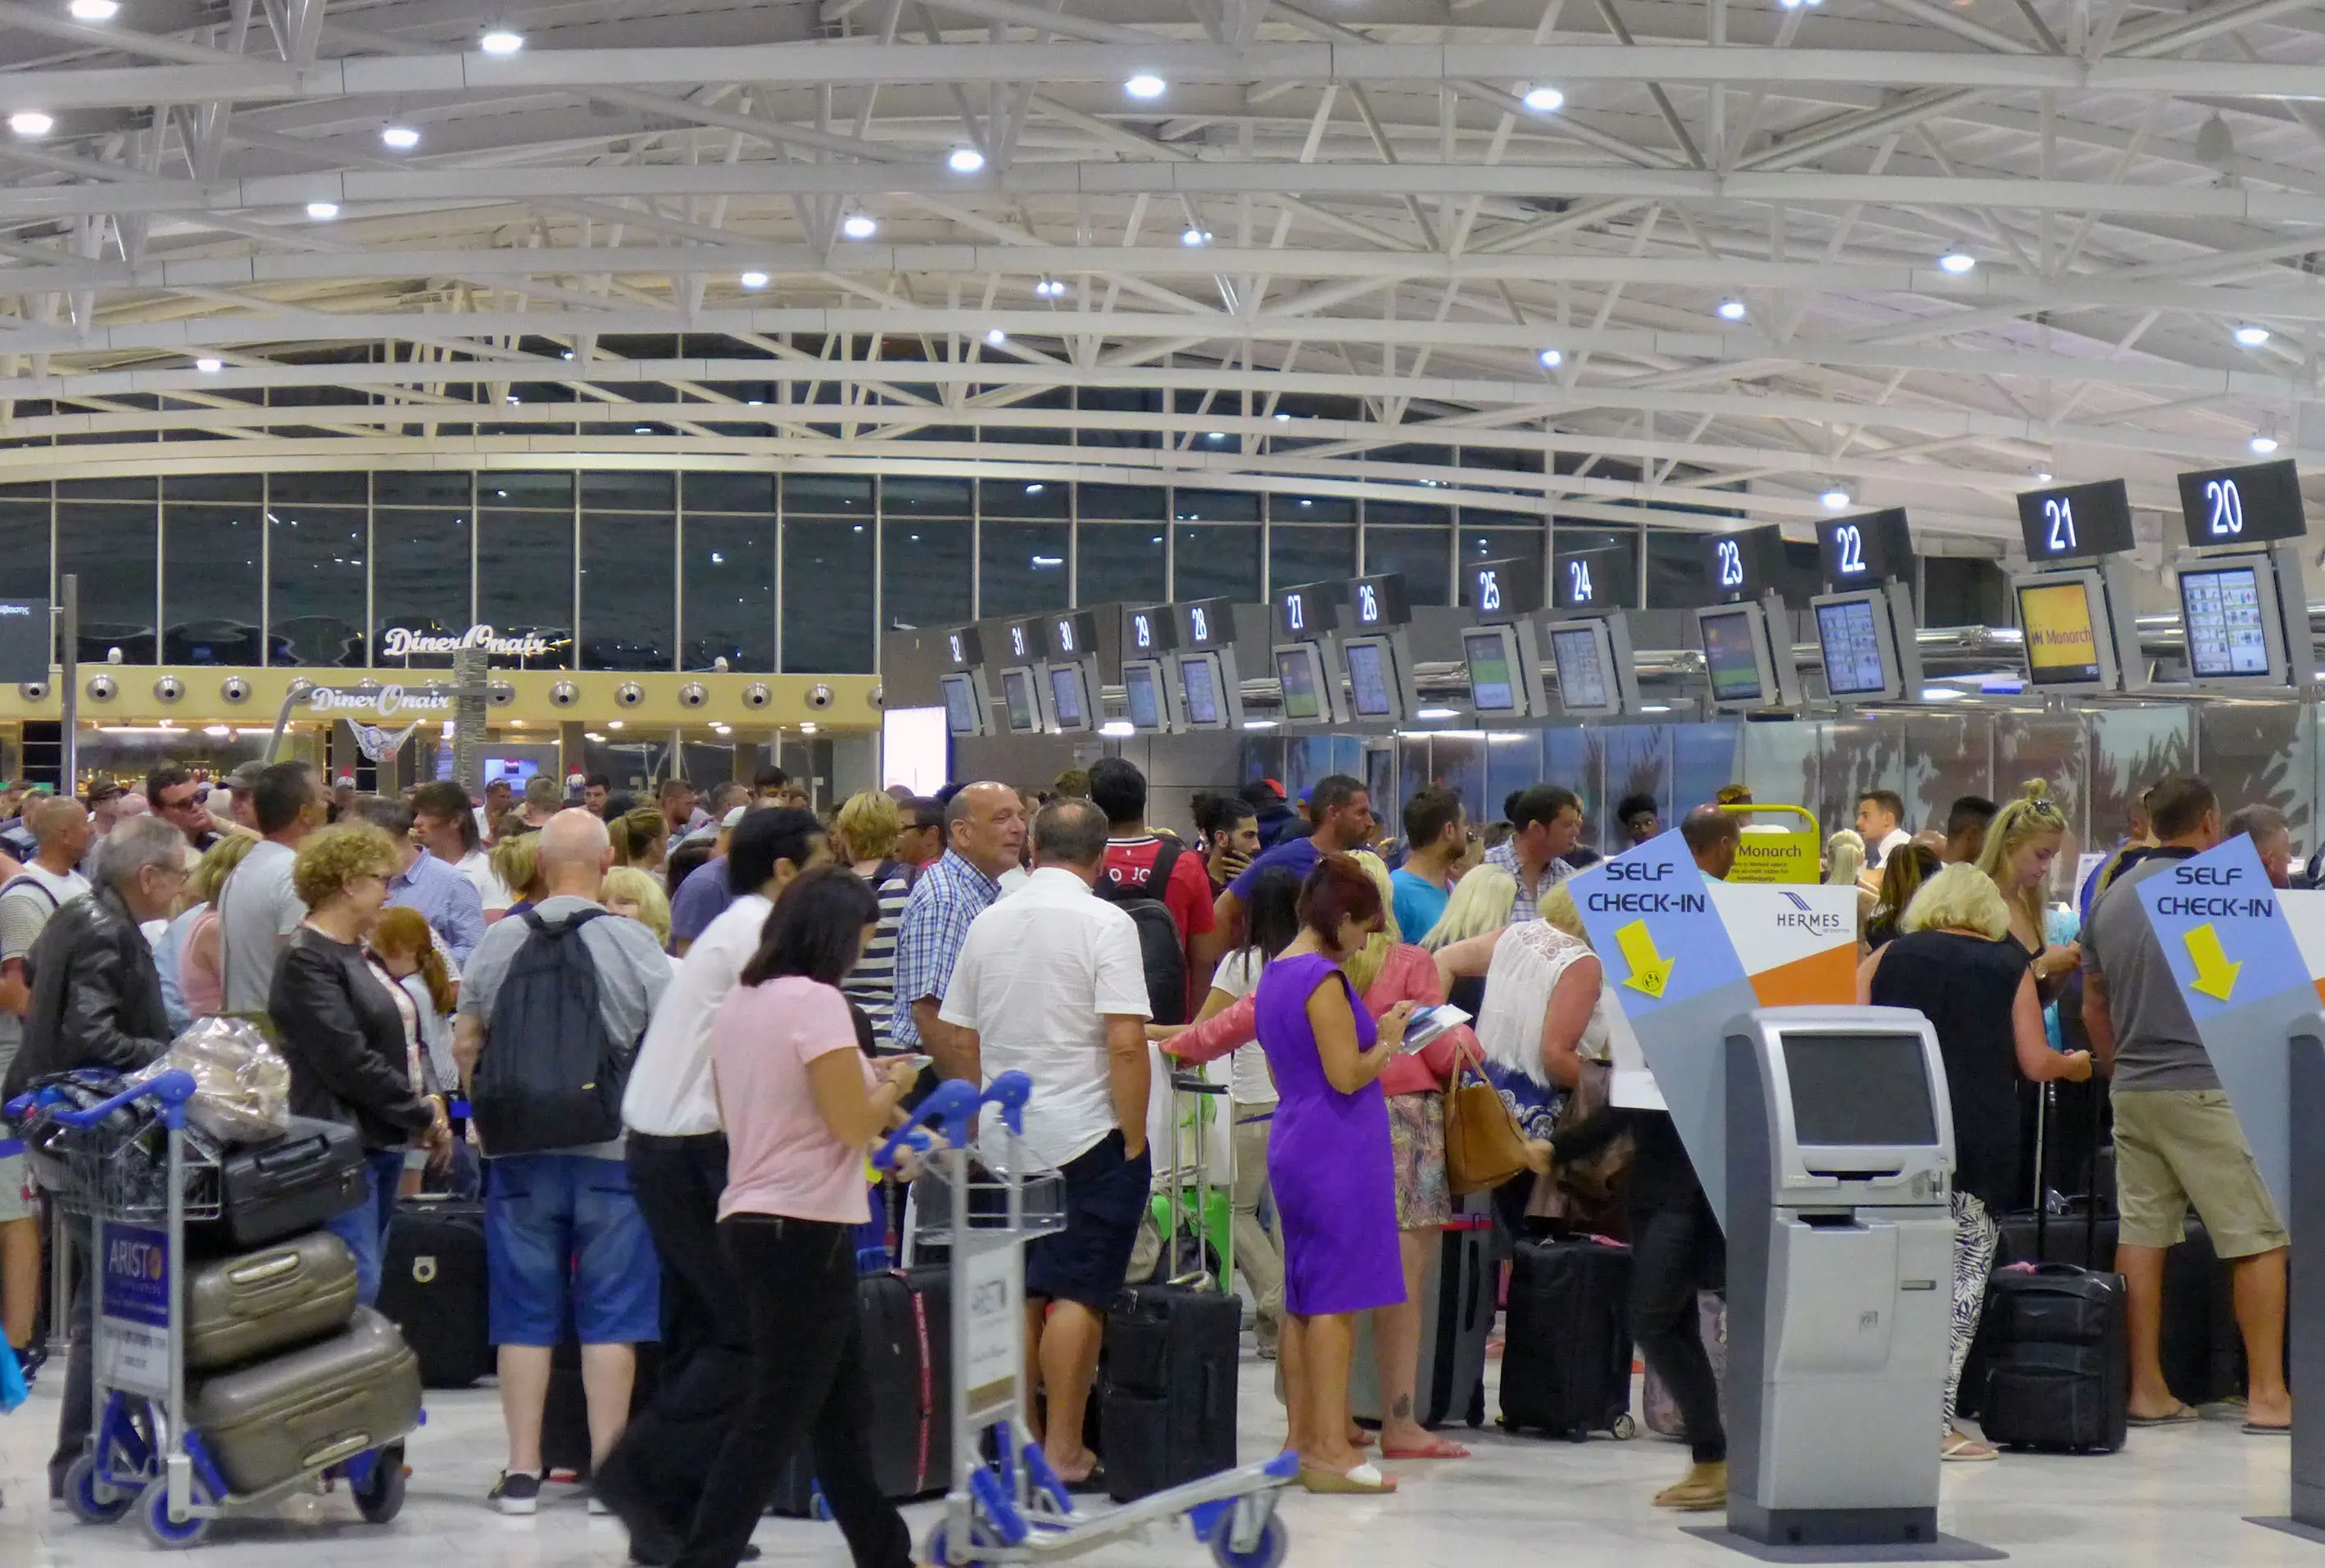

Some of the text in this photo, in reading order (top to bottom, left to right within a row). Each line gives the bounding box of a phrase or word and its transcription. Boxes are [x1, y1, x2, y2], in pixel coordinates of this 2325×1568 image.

[2207, 478, 2243, 533] 20
[2045, 496, 2077, 550] 21
[1719, 540, 1743, 585] 23
[1837, 525, 1866, 573] 22
[1480, 571, 1500, 610] 25
[1571, 560, 1592, 601] 24
[1289, 594, 1303, 628] 27
[1360, 585, 1377, 621] 26
[1060, 620, 1073, 651] 30
[1135, 614, 1149, 647] 29
[1192, 608, 1207, 641] 28
[2046, 626, 2093, 646] Monarch
[950, 634, 963, 663] 32
[1012, 627, 1025, 656] 31
[1739, 844, 1802, 858] Monarch
[1606, 863, 1674, 881] SELF
[2175, 867, 2242, 886] SELF
[1588, 893, 1705, 913] CHECK-IN
[2157, 896, 2273, 918] CHECK-IN
[1777, 913, 1840, 936] HERMES
